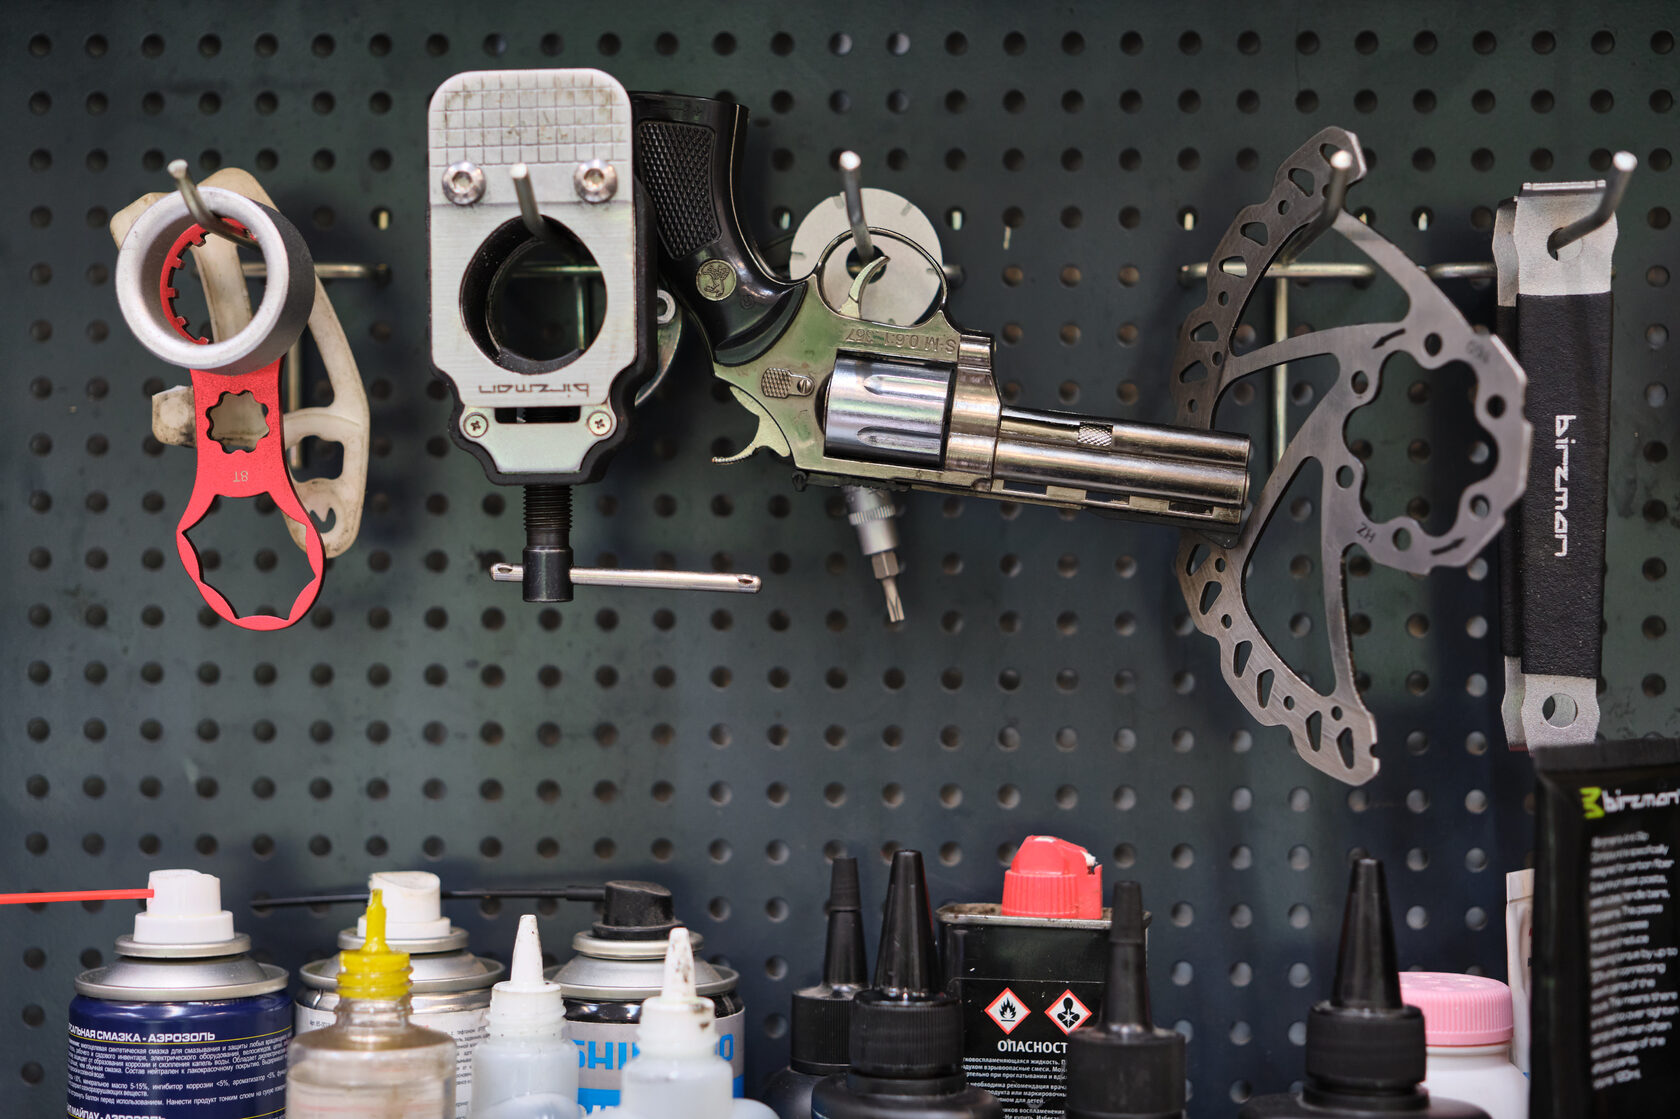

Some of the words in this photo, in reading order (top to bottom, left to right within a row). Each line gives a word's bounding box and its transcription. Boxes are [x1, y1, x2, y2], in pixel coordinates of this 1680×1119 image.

[478, 383, 590, 398] birzman
[232, 470, 249, 482] 8T
[1554, 414, 1577, 557] birzman
[1356, 521, 1376, 543] ZH
[1602, 787, 1680, 813] birzman
[97, 1030, 141, 1042] СМАЗКА
[148, 1032, 216, 1042] АЭРОЗОЛЬ
[571, 1033, 734, 1071] SHIO
[997, 1039, 1068, 1053] ОПАСНОСТ
[194, 1097, 217, 1105] продукт
